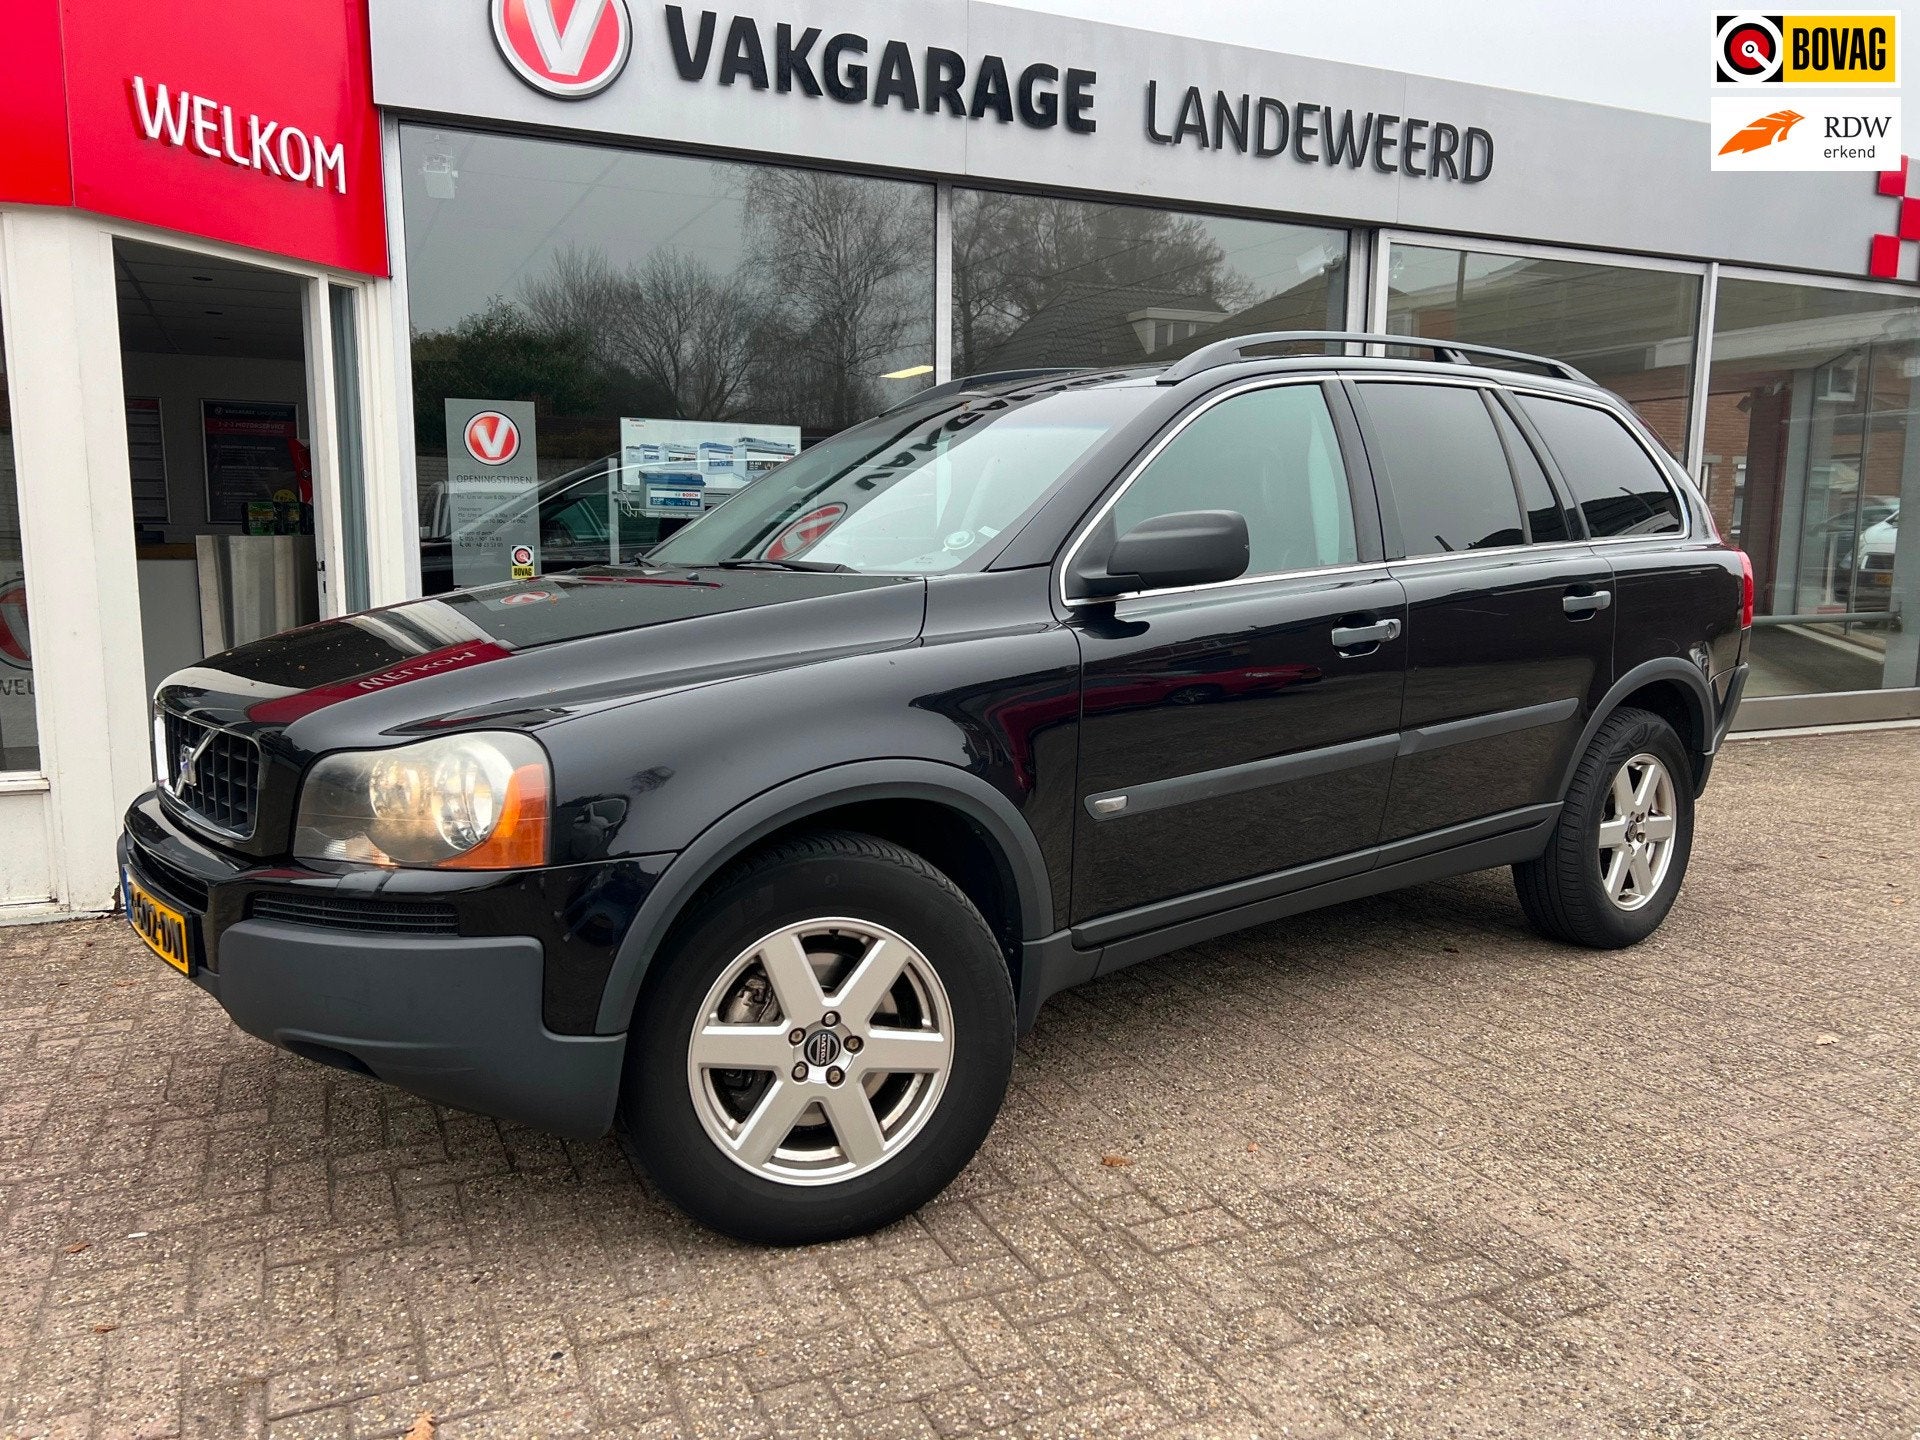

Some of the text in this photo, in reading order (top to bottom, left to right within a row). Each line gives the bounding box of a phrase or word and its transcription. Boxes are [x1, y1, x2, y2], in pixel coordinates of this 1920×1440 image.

[664, 4, 1495, 183] VAKGARAGE LANDEWEERD
[134, 75, 346, 195] WELKOM
[456, 474, 533, 485] OPENINGSTIJDEN
[513, 567, 533, 576] BOVAG
[820, 1033, 828, 1065] VOLVO
